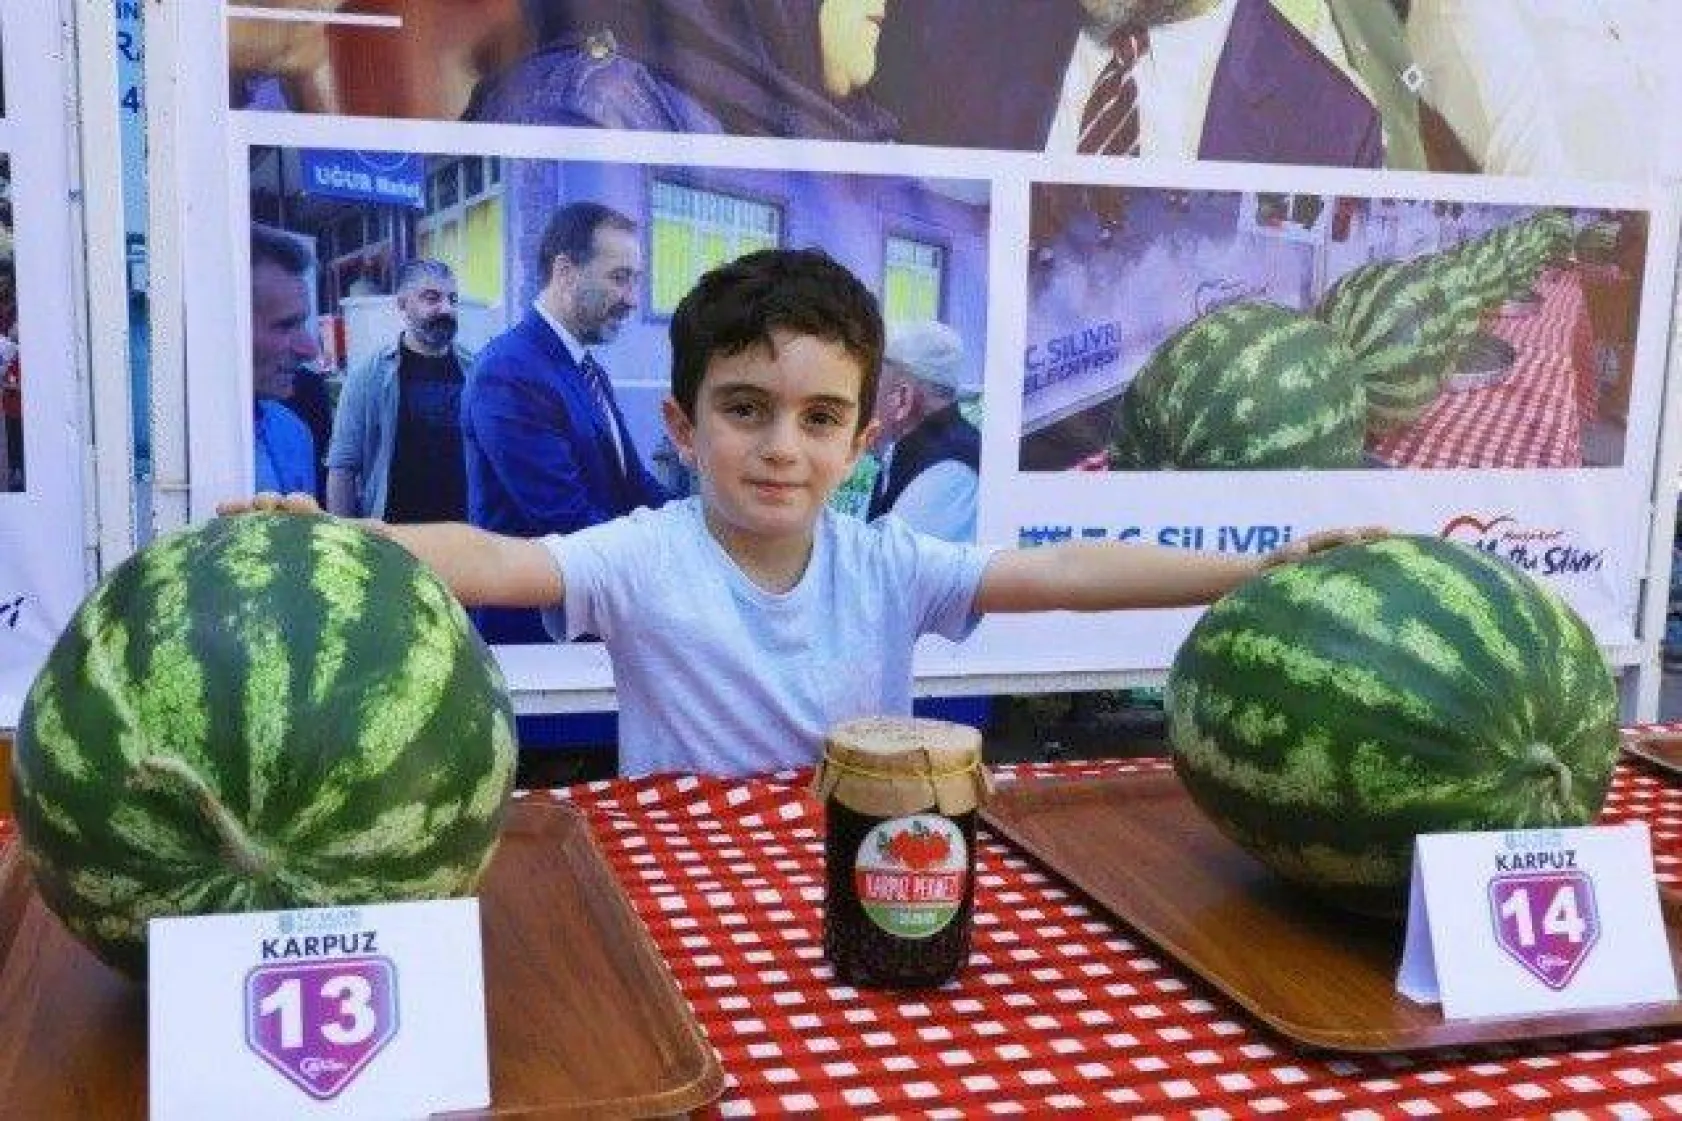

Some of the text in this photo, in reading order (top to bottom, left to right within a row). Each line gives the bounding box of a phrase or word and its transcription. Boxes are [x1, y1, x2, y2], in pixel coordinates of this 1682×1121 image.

[1496, 849, 1578, 872] KARPUZ
[1502, 885, 1587, 947] 14
[262, 930, 379, 959] KARPUZ
[259, 974, 377, 1049] 13
